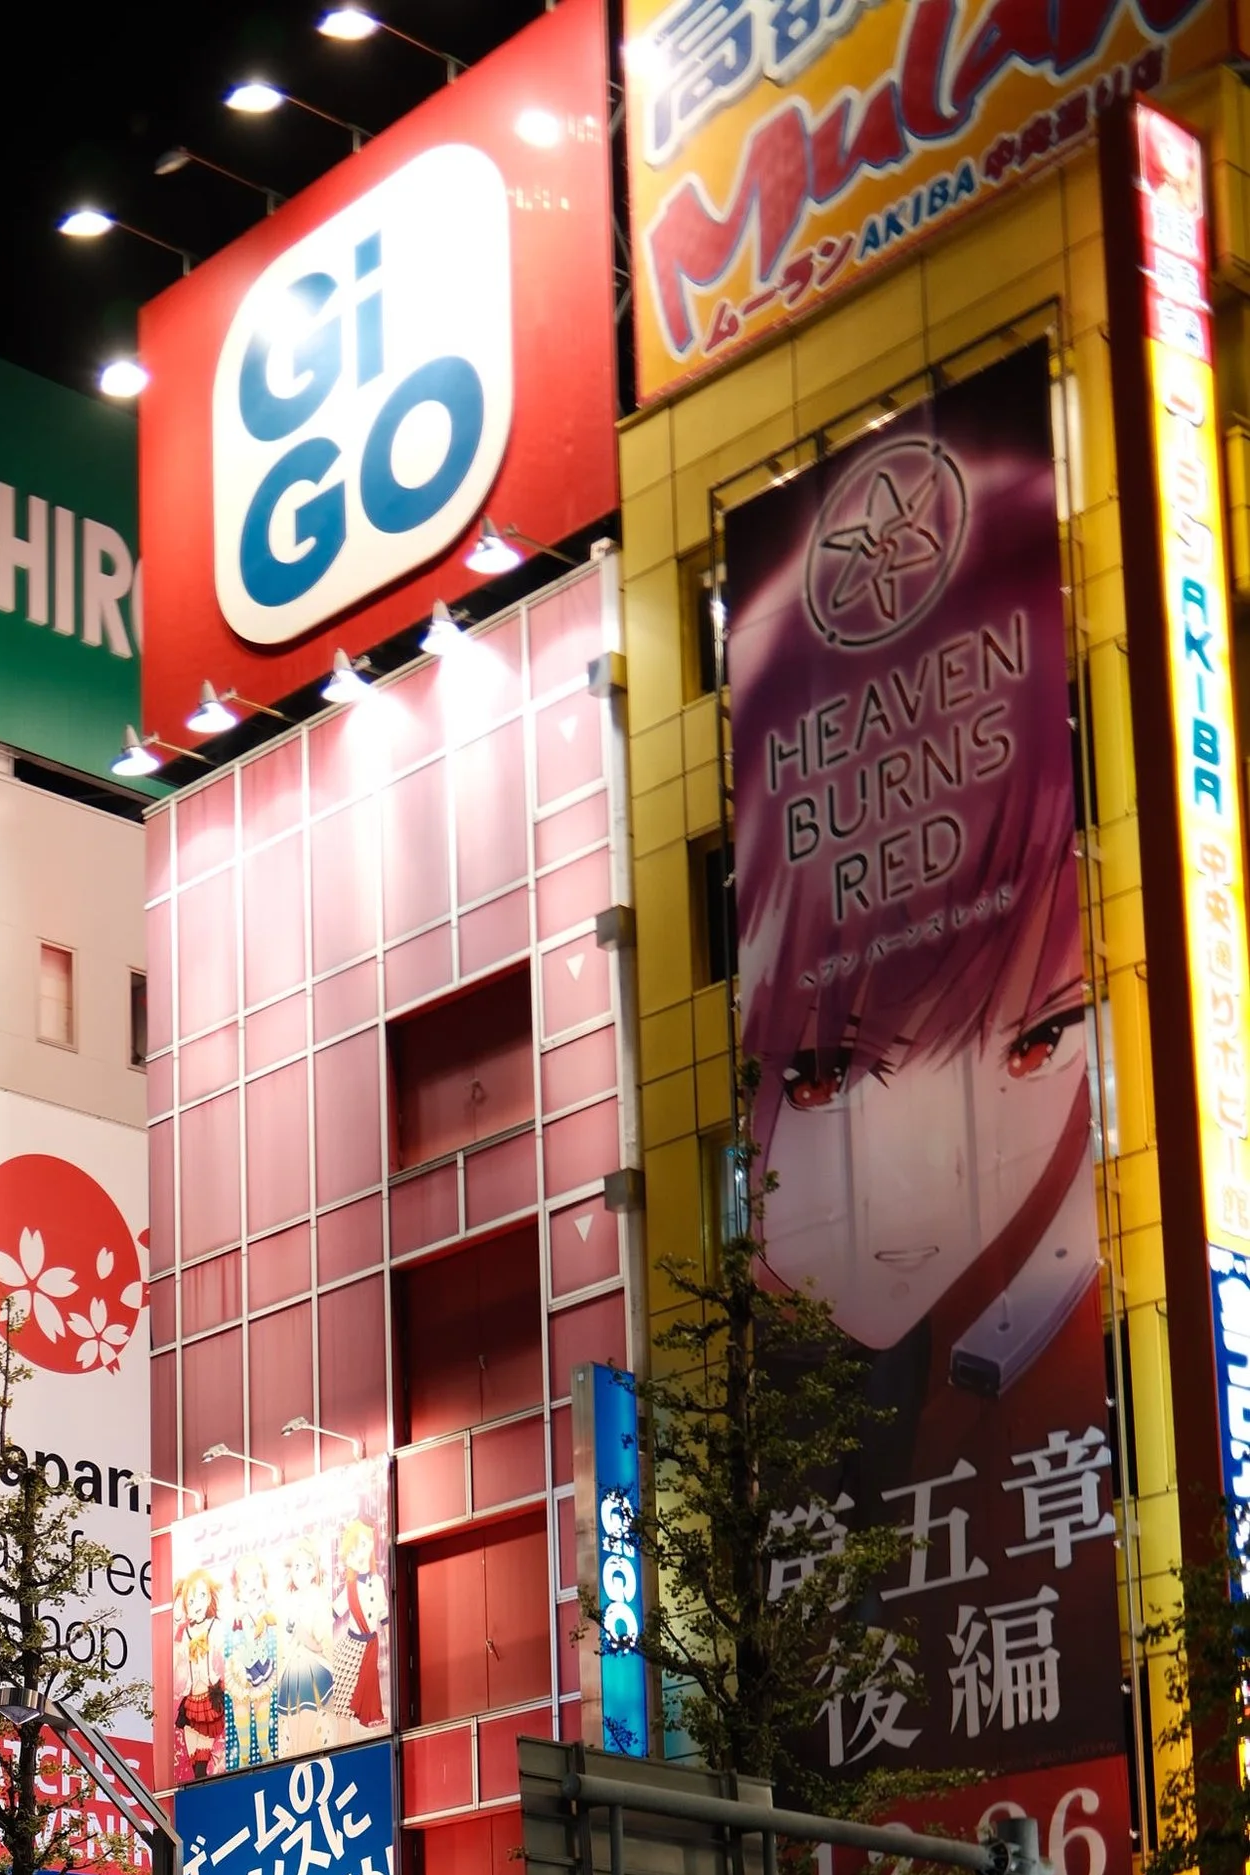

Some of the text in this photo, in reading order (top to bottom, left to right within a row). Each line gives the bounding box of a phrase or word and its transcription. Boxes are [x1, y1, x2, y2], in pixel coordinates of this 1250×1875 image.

[702, 234, 856, 354] ムーラン
[856, 160, 978, 262] AKIBA
[767, 610, 1028, 793] HEAVEN
[787, 704, 1013, 863] BURNS
[833, 813, 964, 923] RED
[812, 1584, 1062, 1768] 後編
